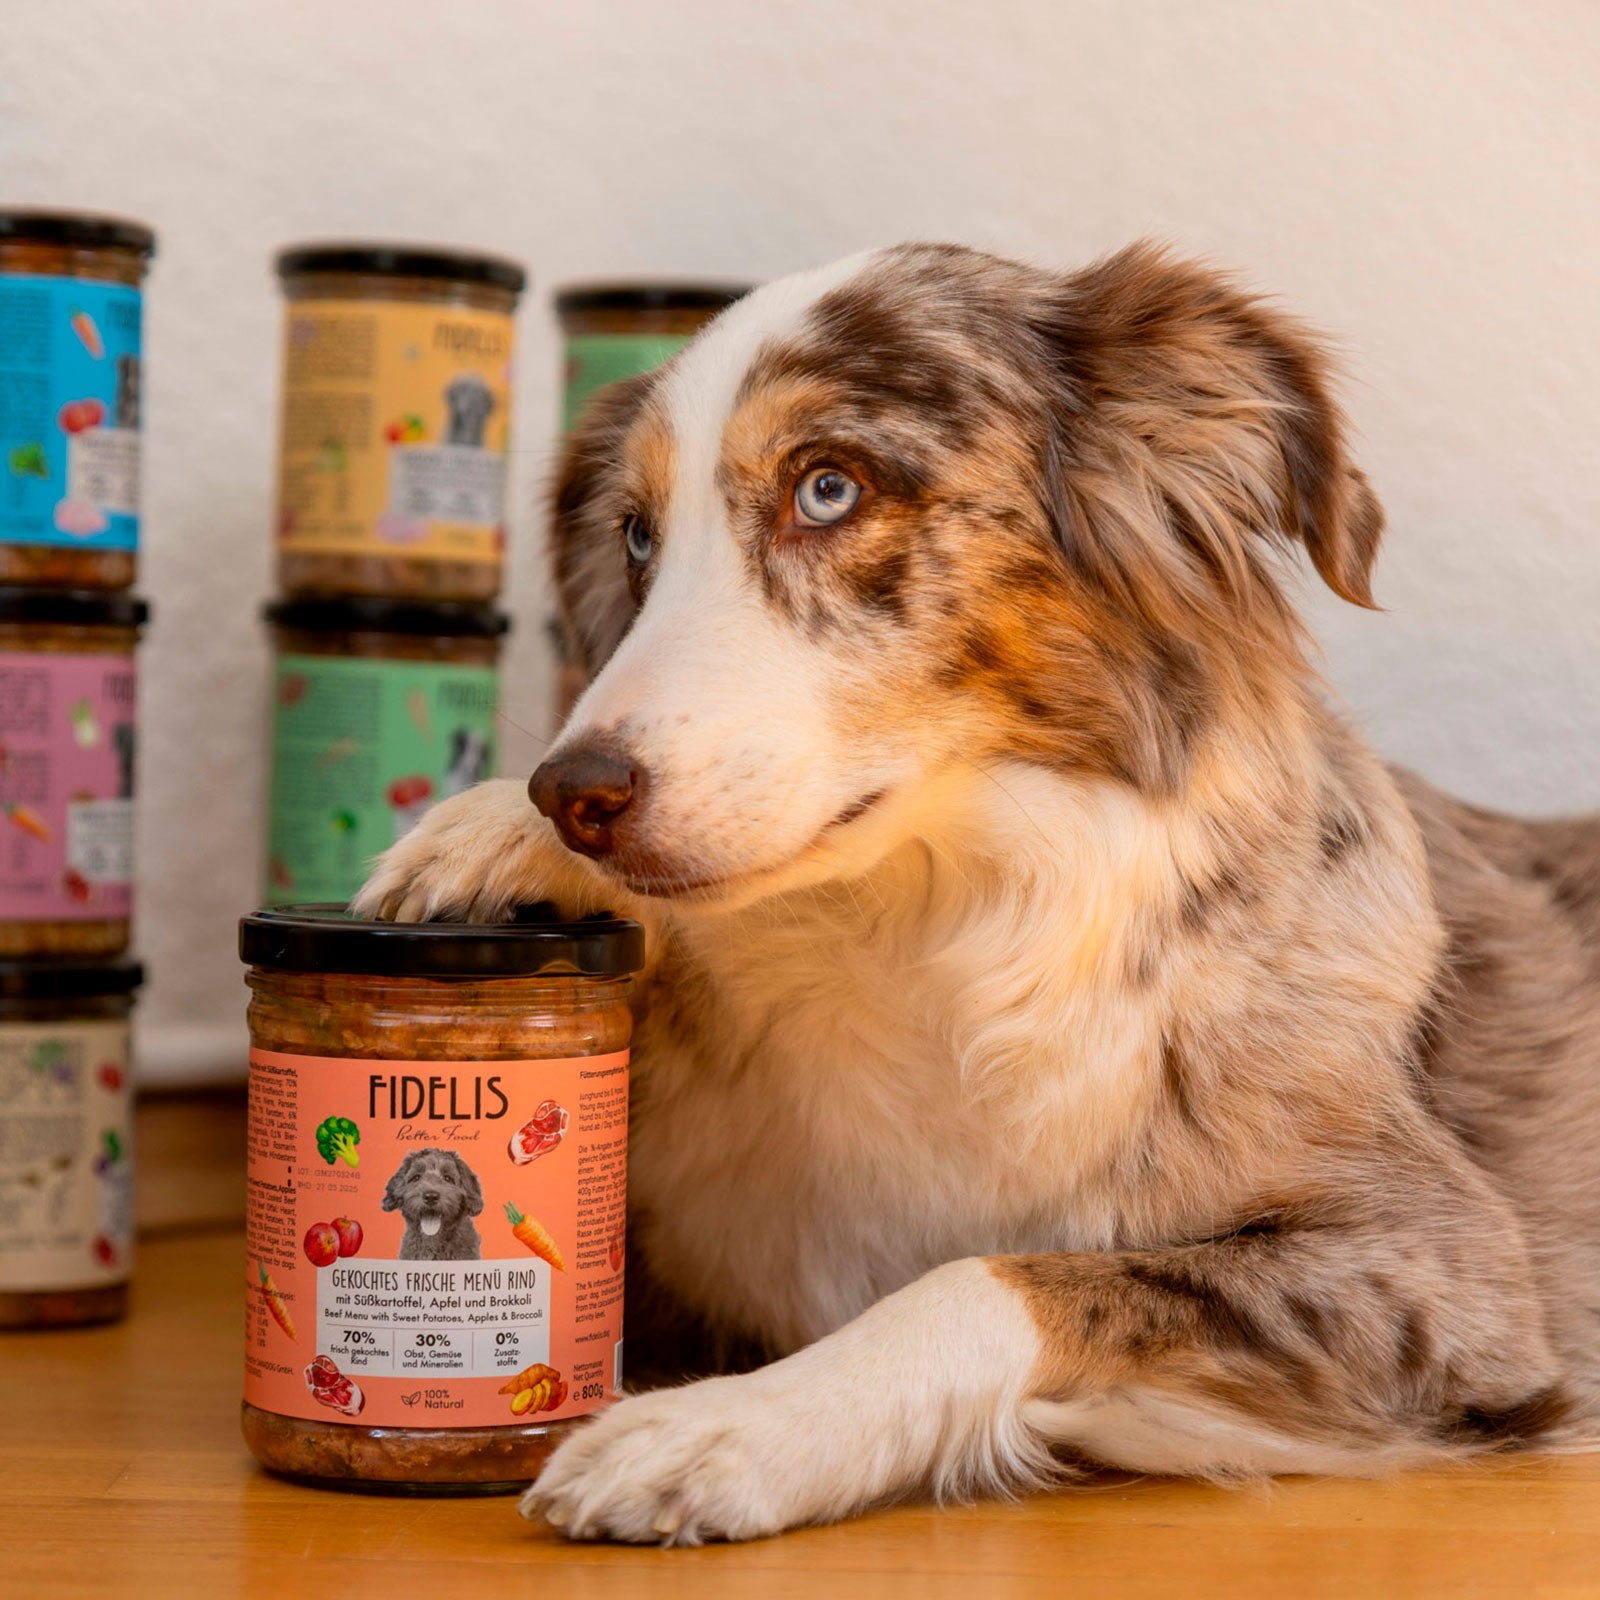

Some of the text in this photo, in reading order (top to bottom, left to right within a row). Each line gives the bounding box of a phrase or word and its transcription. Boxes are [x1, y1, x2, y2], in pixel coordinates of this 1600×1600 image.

[370, 1075, 508, 1120] FIDELIS
[396, 1124, 481, 1141] Better Food
[332, 1269, 536, 1292] GEKOCHTES FRISCHE MENÜ RIND
[336, 1294, 532, 1311] mit Süßkartoffel, Apfel und Brokkoli
[325, 1309, 342, 1318] Beef
[345, 1311, 368, 1320] Menu
[371, 1312, 389, 1322] with
[392, 1313, 420, 1322] Sweet
[423, 1314, 464, 1323] Potatoes,
[467, 1313, 498, 1324] Apples
[511, 1310, 542, 1320] Broccoli
[343, 1331, 375, 1344] 70%
[416, 1334, 451, 1347] 30%
[496, 1332, 519, 1345] 0%
[330, 1345, 389, 1358] frisch gekochtes
[404, 1350, 462, 1359] Obst, Gemüse
[494, 1348, 521, 1356] Zusatz-
[351, 1356, 367, 1365] Rind
[403, 1359, 463, 1368] und Mineralien
[497, 1359, 518, 1367] stoffe
[424, 1390, 450, 1398] 100%
[582, 1382, 603, 1400] 800g
[424, 1400, 464, 1409] Natural
